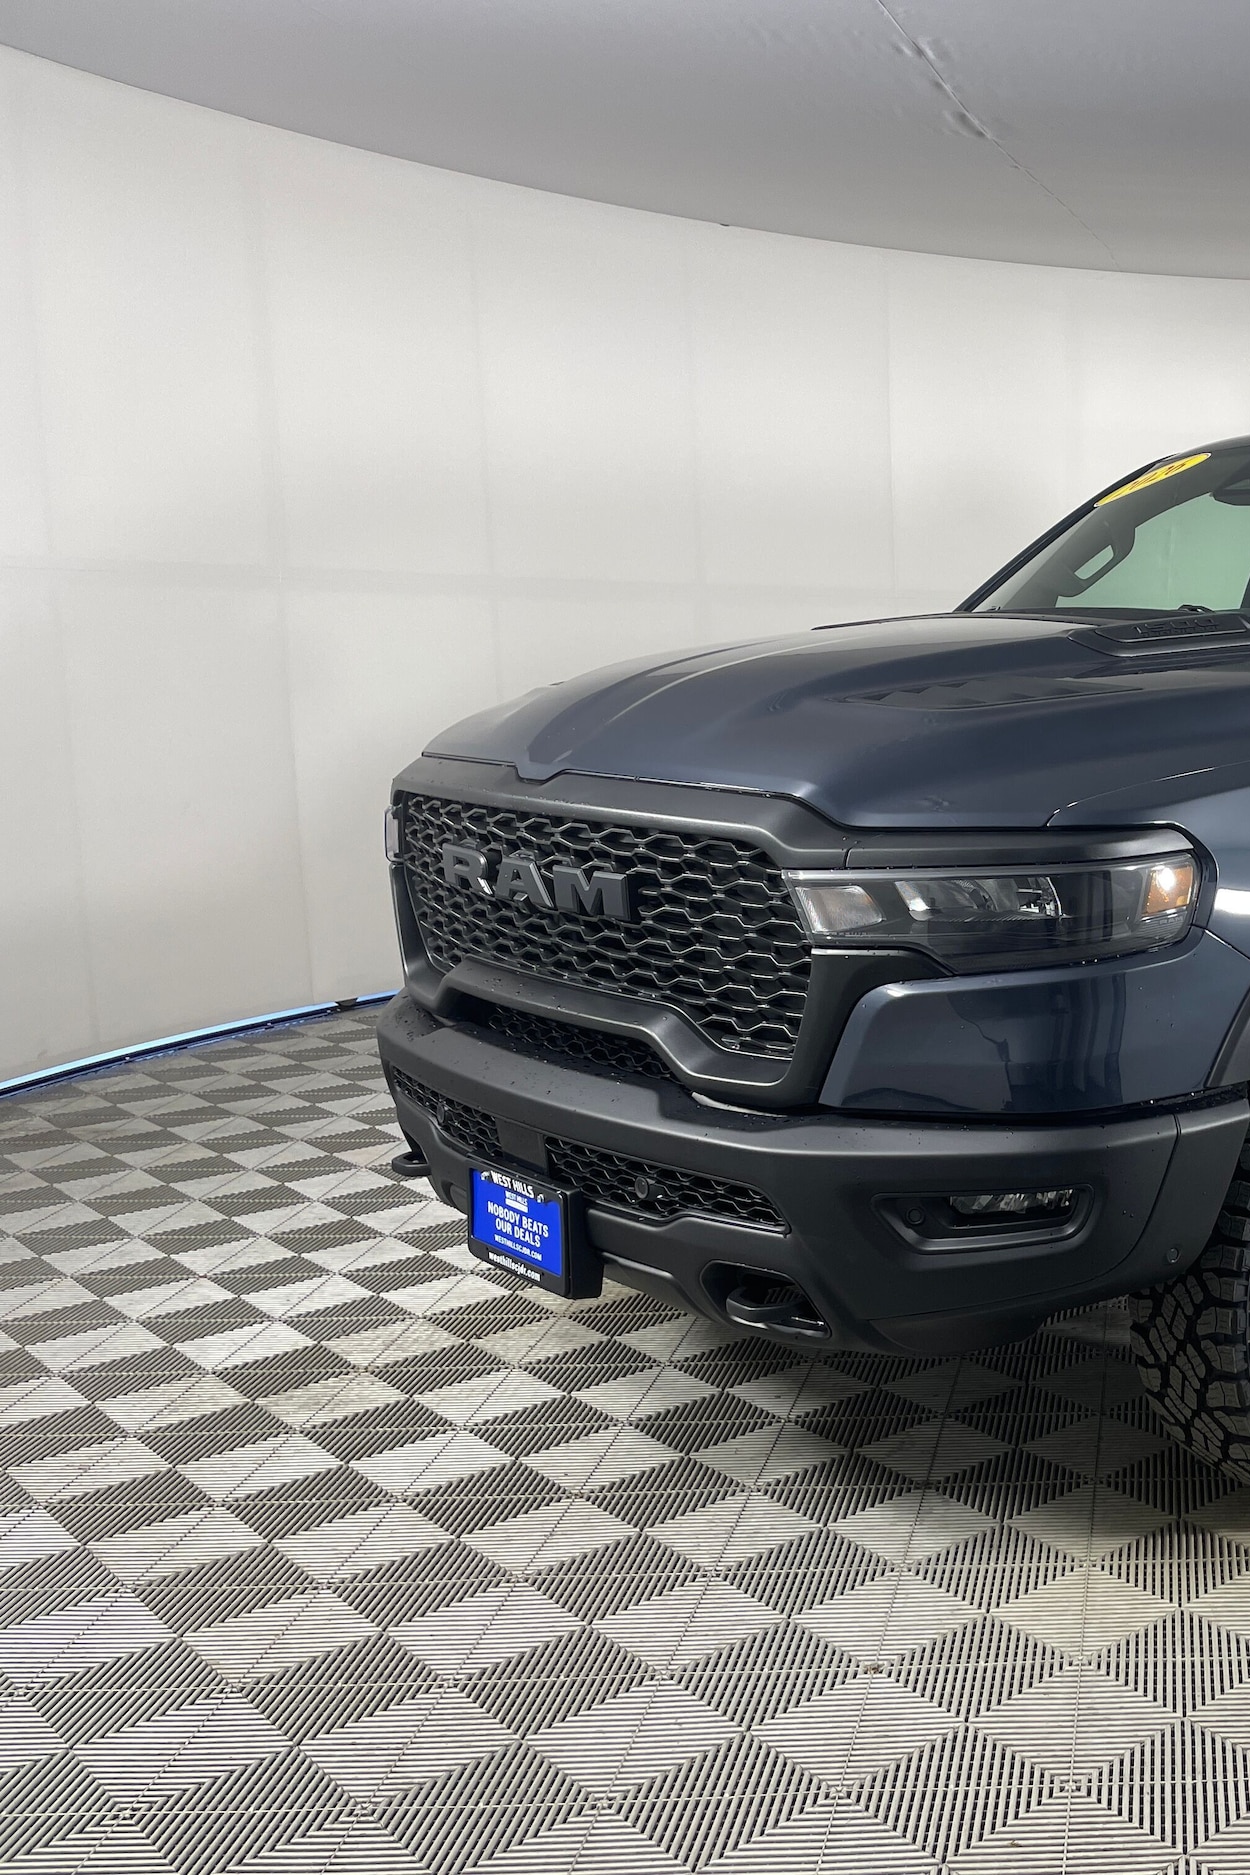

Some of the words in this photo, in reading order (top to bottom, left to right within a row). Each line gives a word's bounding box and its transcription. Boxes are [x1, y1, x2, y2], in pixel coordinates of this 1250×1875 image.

[1131, 617, 1219, 634] 1500
[442, 843, 632, 921] RAM
[491, 1170, 511, 1189] WEST
[512, 1179, 534, 1198] HILLS
[487, 1201, 520, 1225] NOBODY
[522, 1215, 549, 1238] BEATS
[495, 1217, 513, 1236] OUR
[514, 1225, 541, 1248] DEALS
[488, 1251, 541, 1282] westhillscjdr.com
